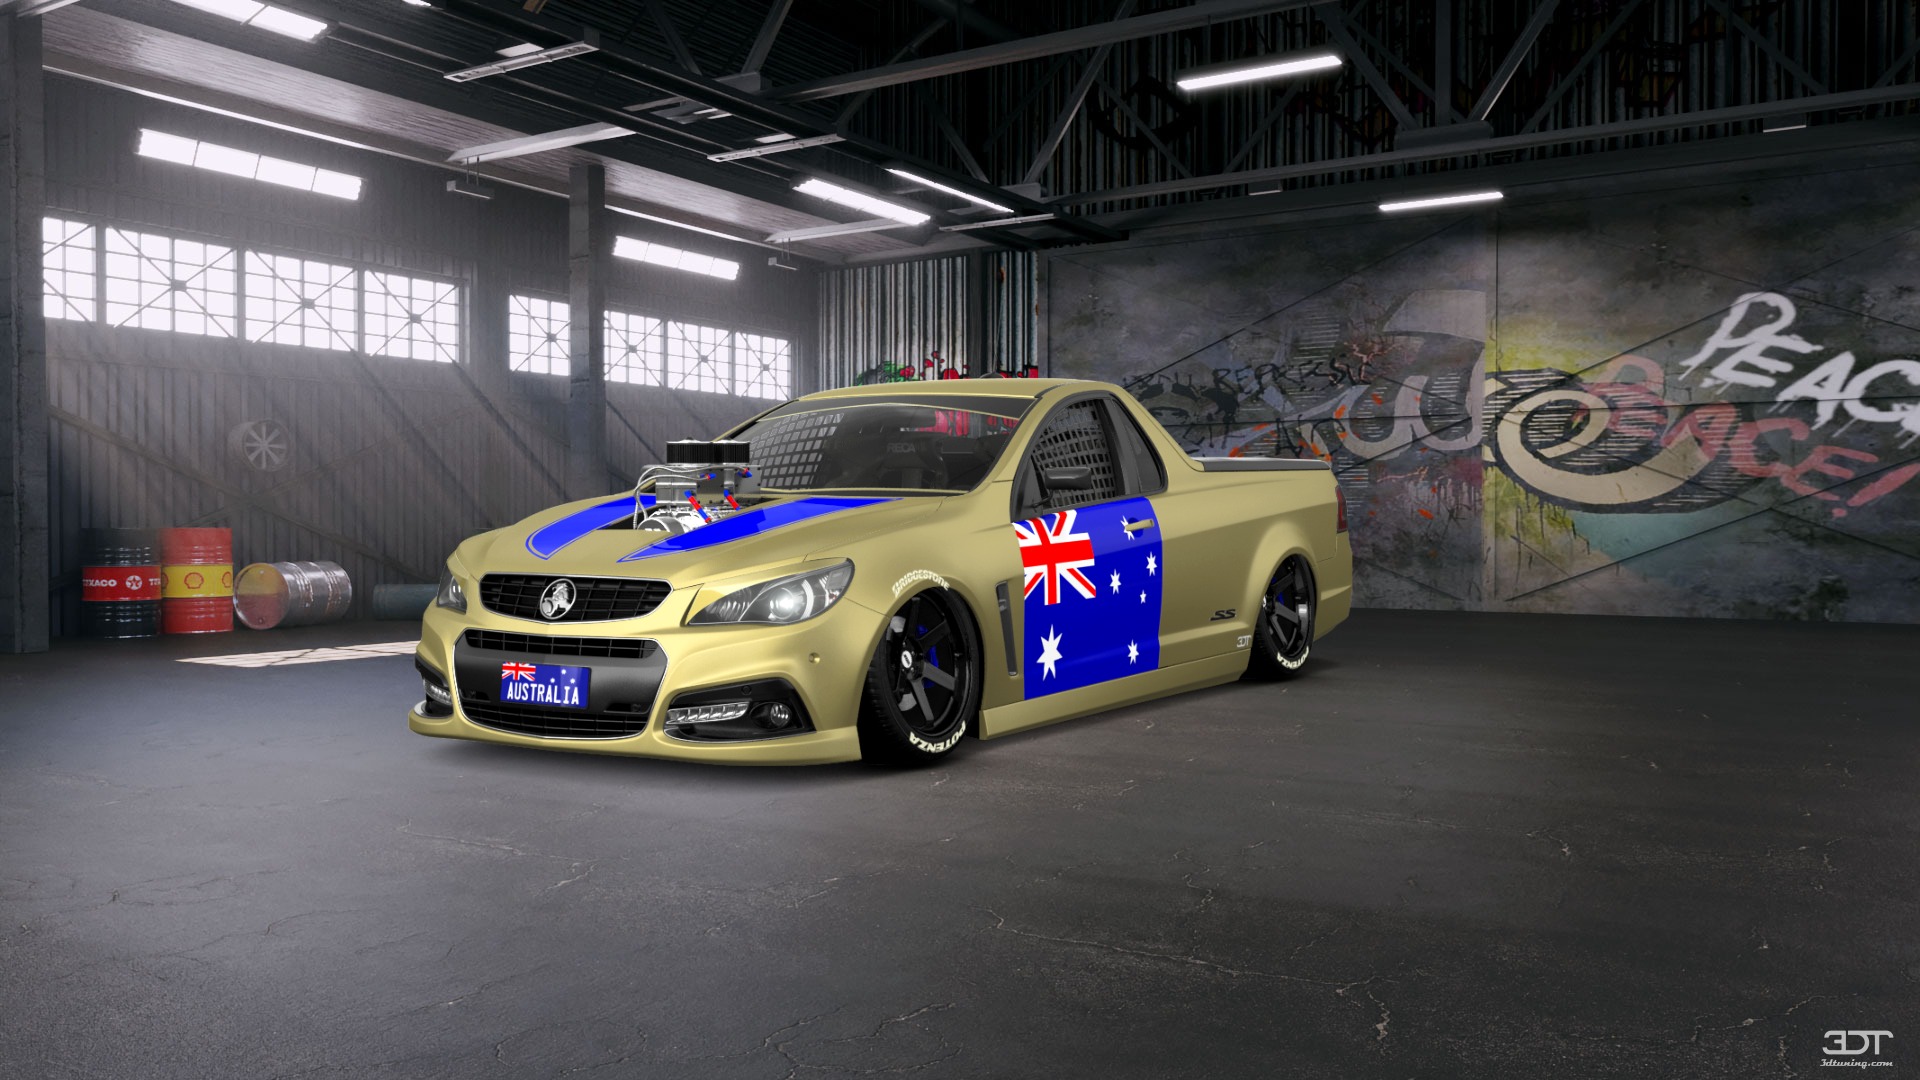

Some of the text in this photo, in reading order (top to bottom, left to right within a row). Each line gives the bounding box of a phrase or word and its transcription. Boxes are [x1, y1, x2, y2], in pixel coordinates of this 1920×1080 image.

[1678, 292, 1920, 434] PEAC
[1573, 354, 1920, 518] PEACE!
[1210, 609, 1236, 621] SS
[506, 681, 580, 706] AUSTRALIA
[909, 720, 967, 754] POTENZA
